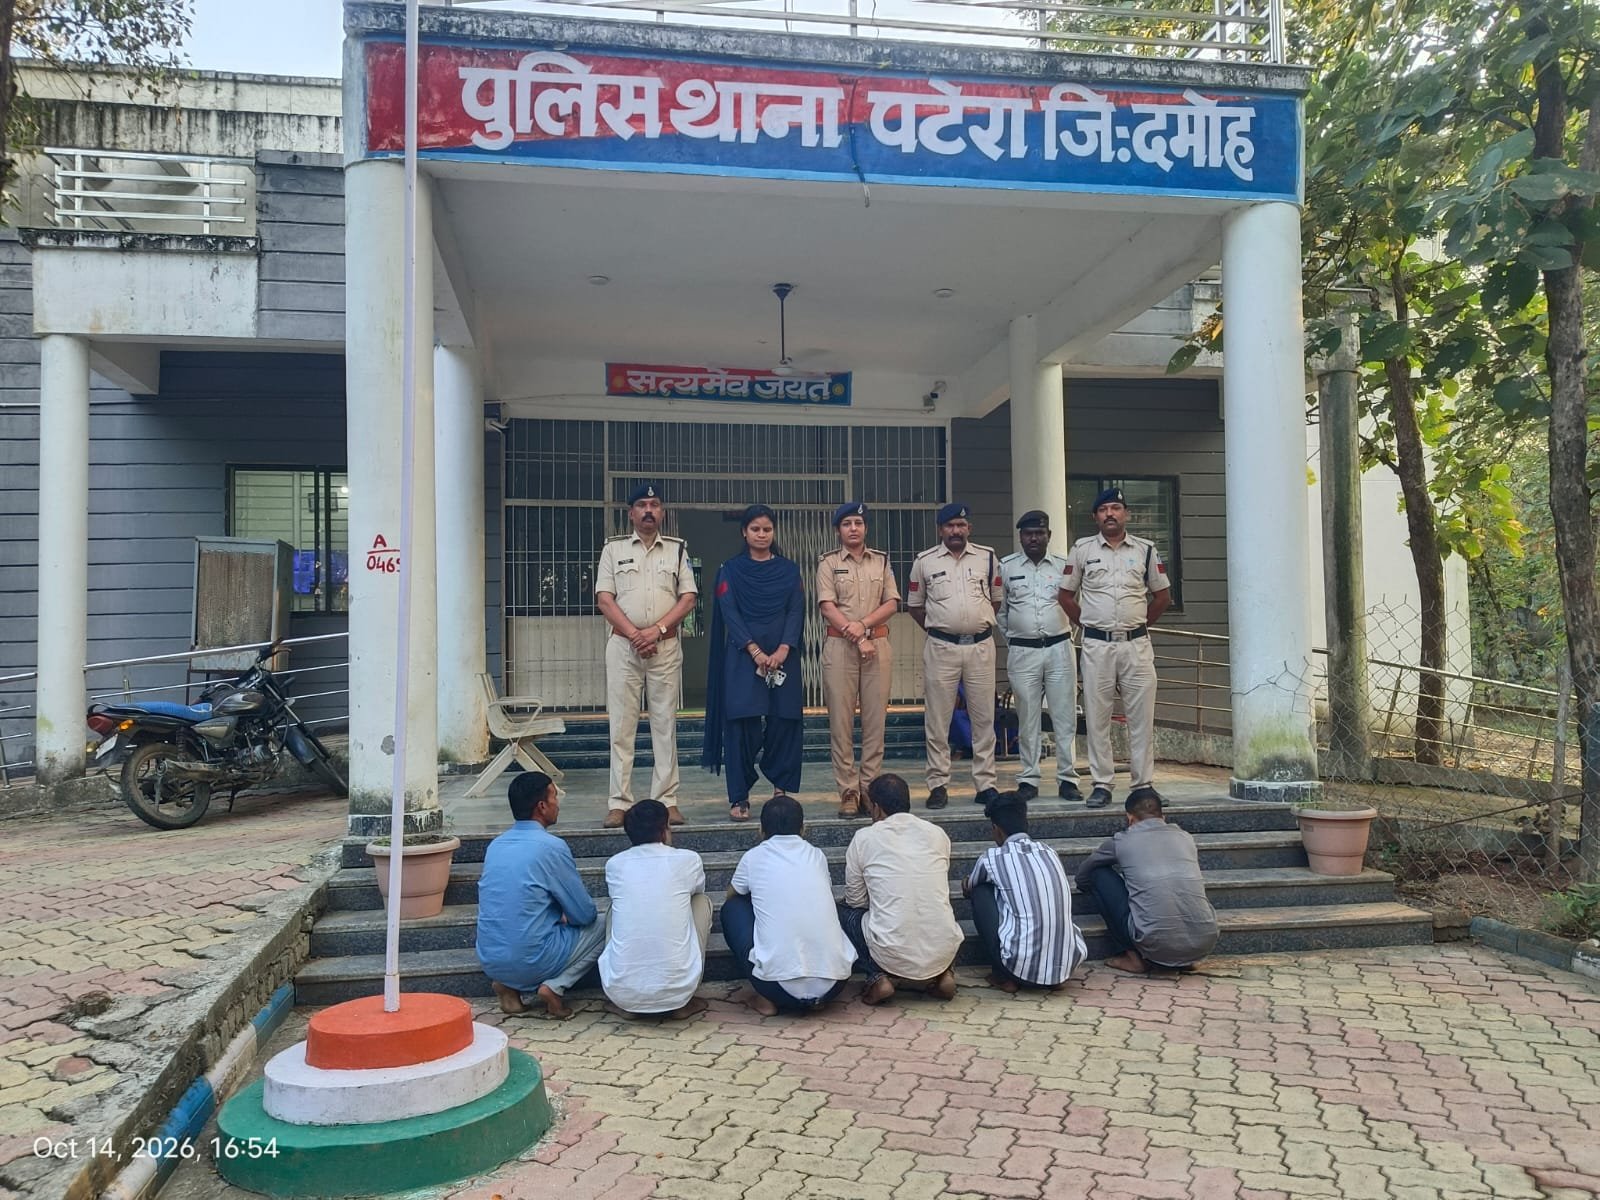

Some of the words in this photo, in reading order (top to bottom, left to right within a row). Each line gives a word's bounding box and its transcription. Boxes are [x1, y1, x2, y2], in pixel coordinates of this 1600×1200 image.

[458, 50, 666, 151] पुलिस
[669, 79, 845, 148] थाना
[867, 77, 1033, 162] पटेरा
[626, 368, 752, 398] सत्यमेव
[373, 534, 387, 548] A
